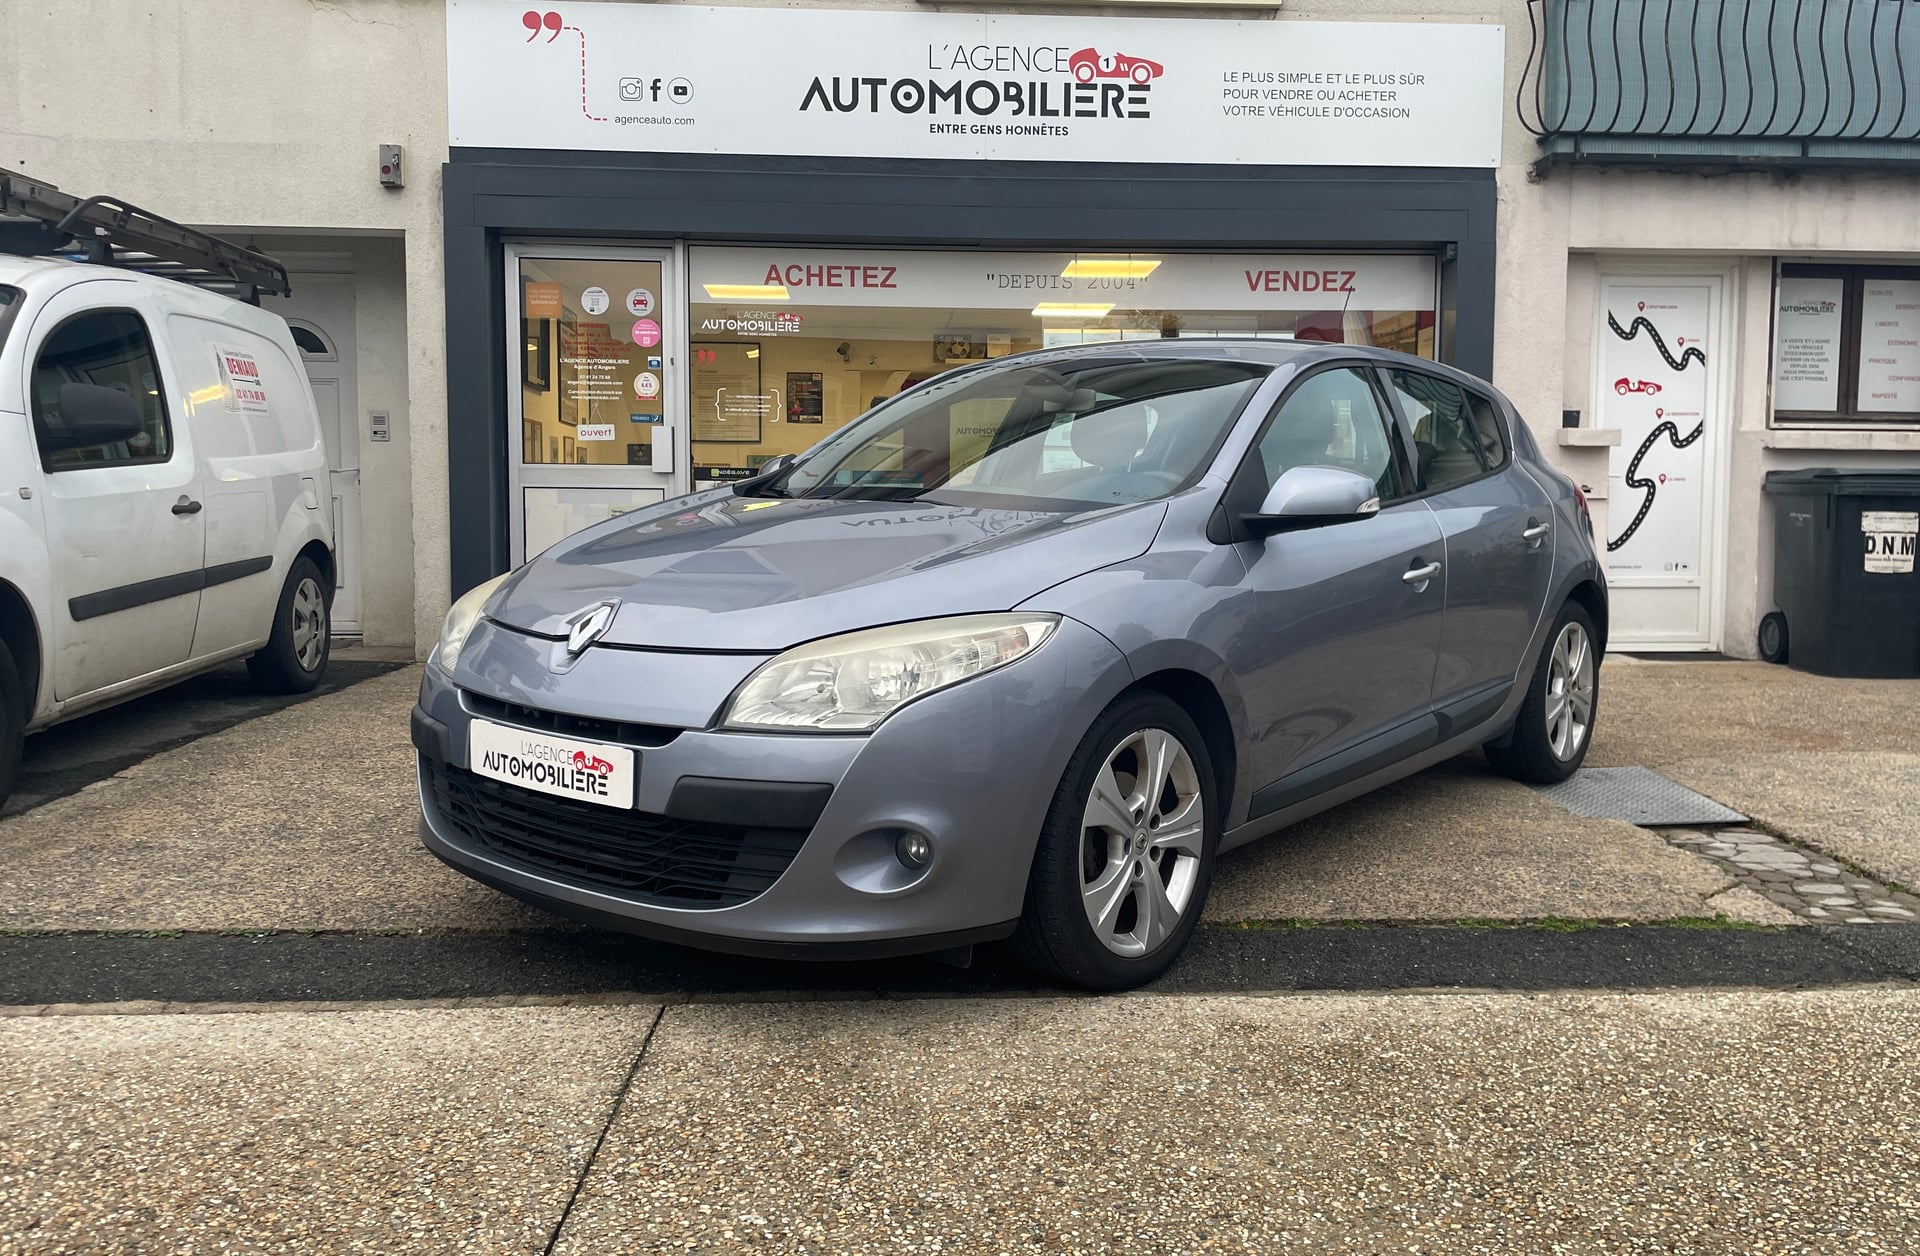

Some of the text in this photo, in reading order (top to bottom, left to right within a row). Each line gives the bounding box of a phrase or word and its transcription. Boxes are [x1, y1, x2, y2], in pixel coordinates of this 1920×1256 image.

[1223, 72, 1425, 85] LE PLUS SIMPLE ET LE PLUS SÛR
[1223, 88, 1397, 102] POUR VENDRE OU ACHETER
[1222, 104, 1410, 118] VOTRE VÉHICULE D'OCCASION
[614, 115, 695, 126] agenceauto.com
[929, 123, 1069, 136] ENTRE GENS HONNÊTES
[764, 264, 897, 288] ACHETEZ
[1245, 270, 1356, 293] VENDEZ
[226, 357, 258, 378] DENIAUD
[580, 428, 612, 437] ouvert
[521, 741, 573, 765] L'AGENCE
